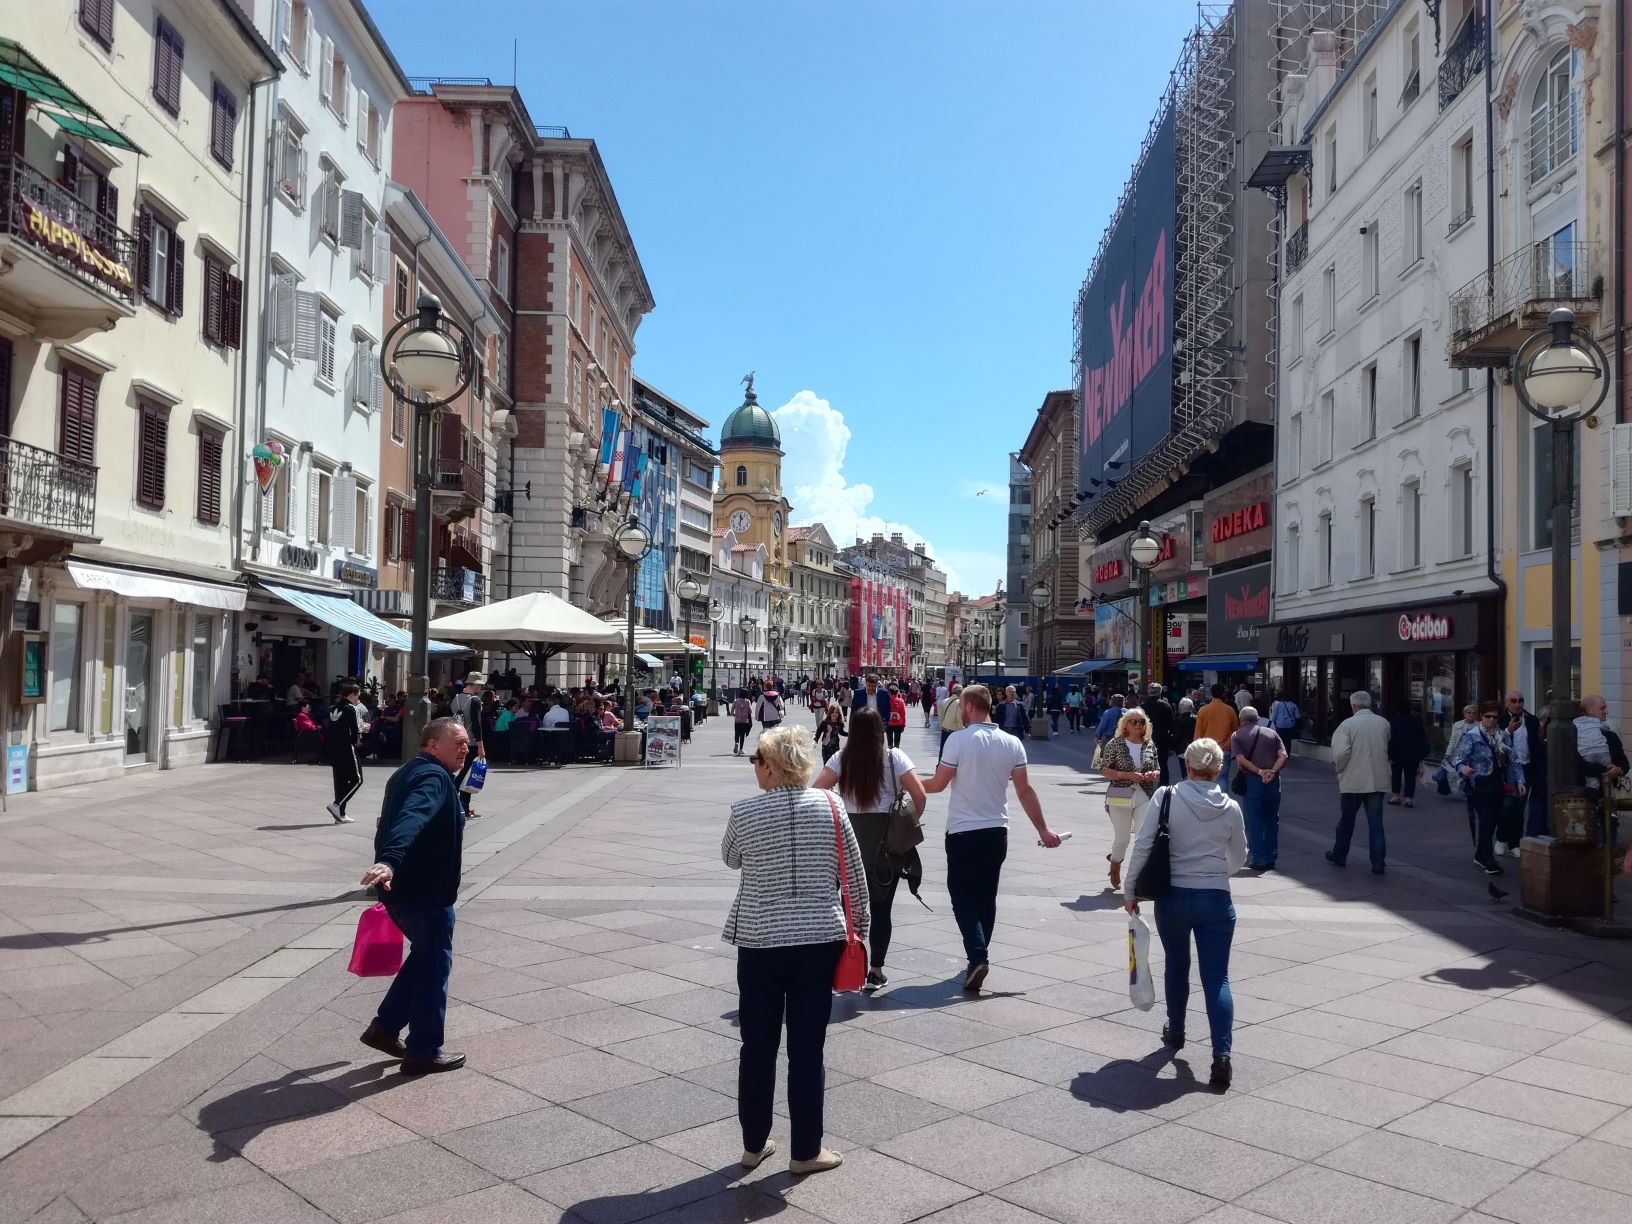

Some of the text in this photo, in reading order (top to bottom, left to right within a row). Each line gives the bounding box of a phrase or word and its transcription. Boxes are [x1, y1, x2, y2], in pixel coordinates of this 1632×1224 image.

[29, 207, 81, 255] HAPPY
[1211, 502, 1264, 543] RIJEKA
[280, 544, 319, 571] CORSO
[1095, 559, 1121, 583] ROBNA
[1411, 615, 1448, 639] ciciban
